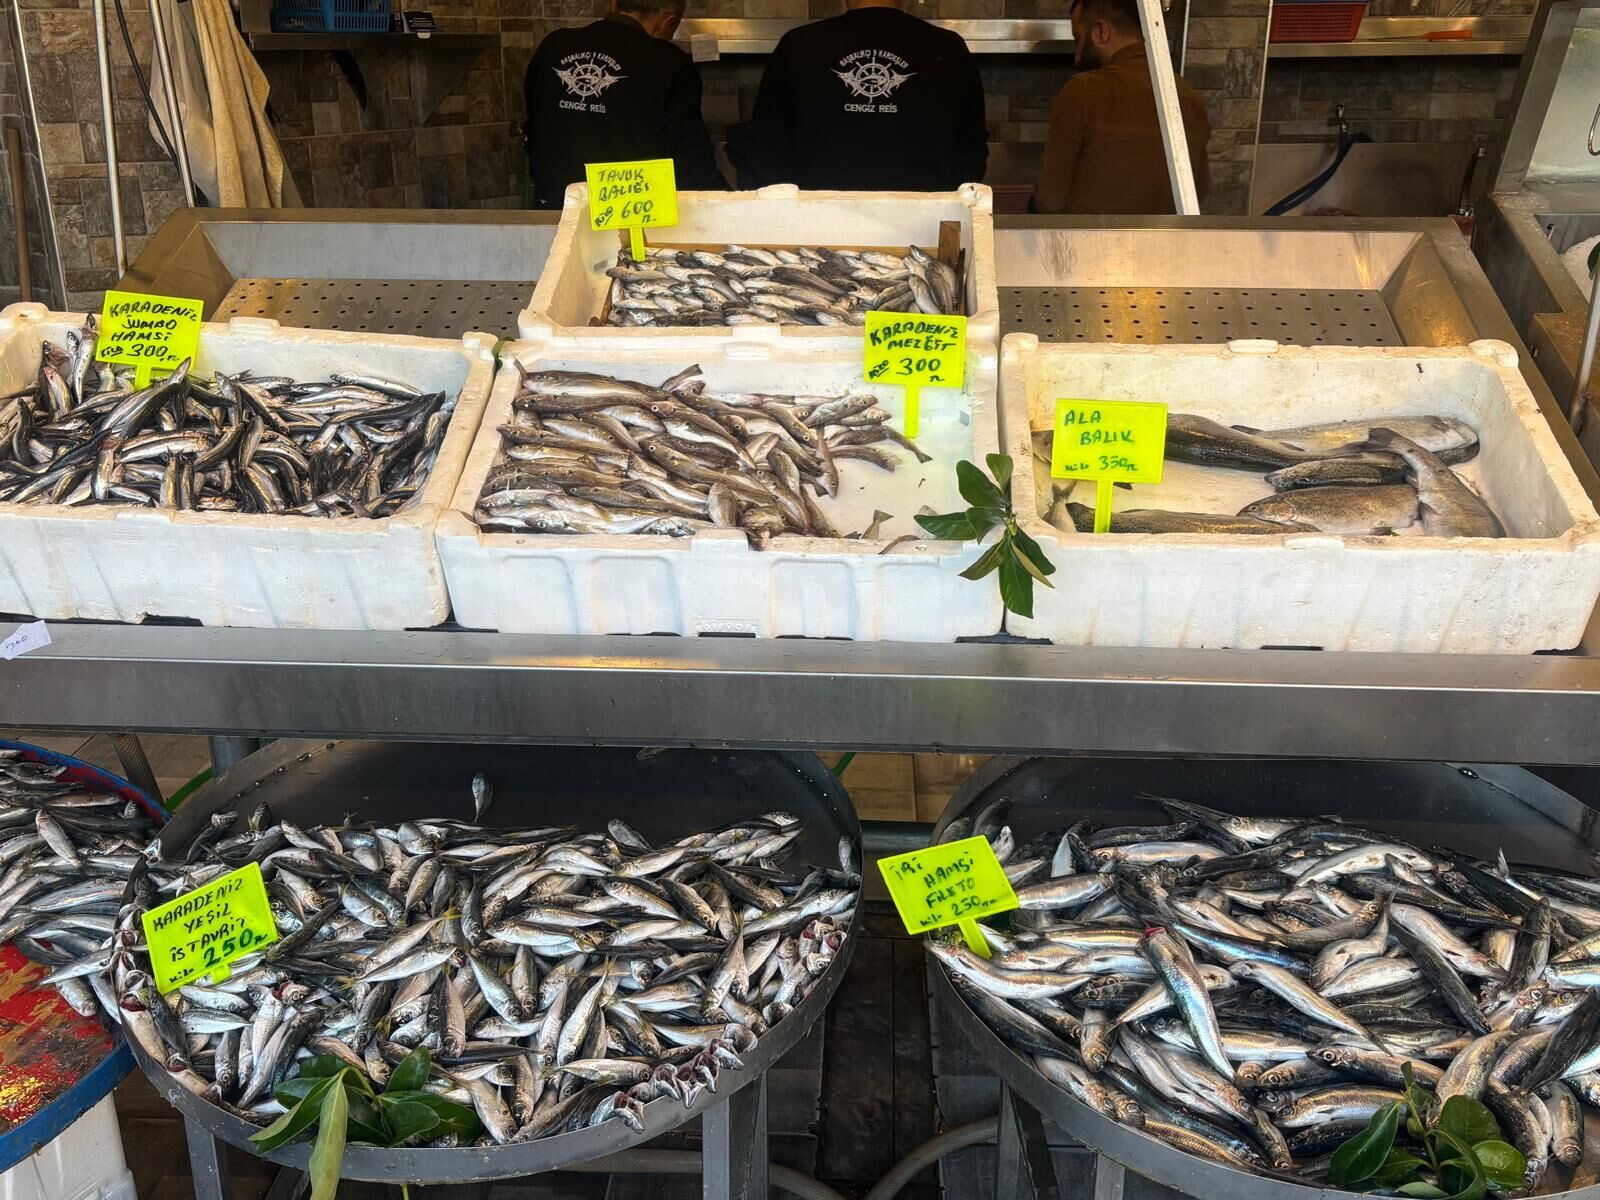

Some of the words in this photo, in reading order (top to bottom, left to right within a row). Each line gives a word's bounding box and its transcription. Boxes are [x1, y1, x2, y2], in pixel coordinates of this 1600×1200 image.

[878, 103, 898, 113] REİS
[598, 168, 645, 183] TAVUK
[621, 200, 654, 219] 600
[895, 357, 942, 376] 300
[1064, 409, 1102, 427] ALA
[1079, 429, 1136, 446] BALIK
[203, 927, 254, 968] 250
